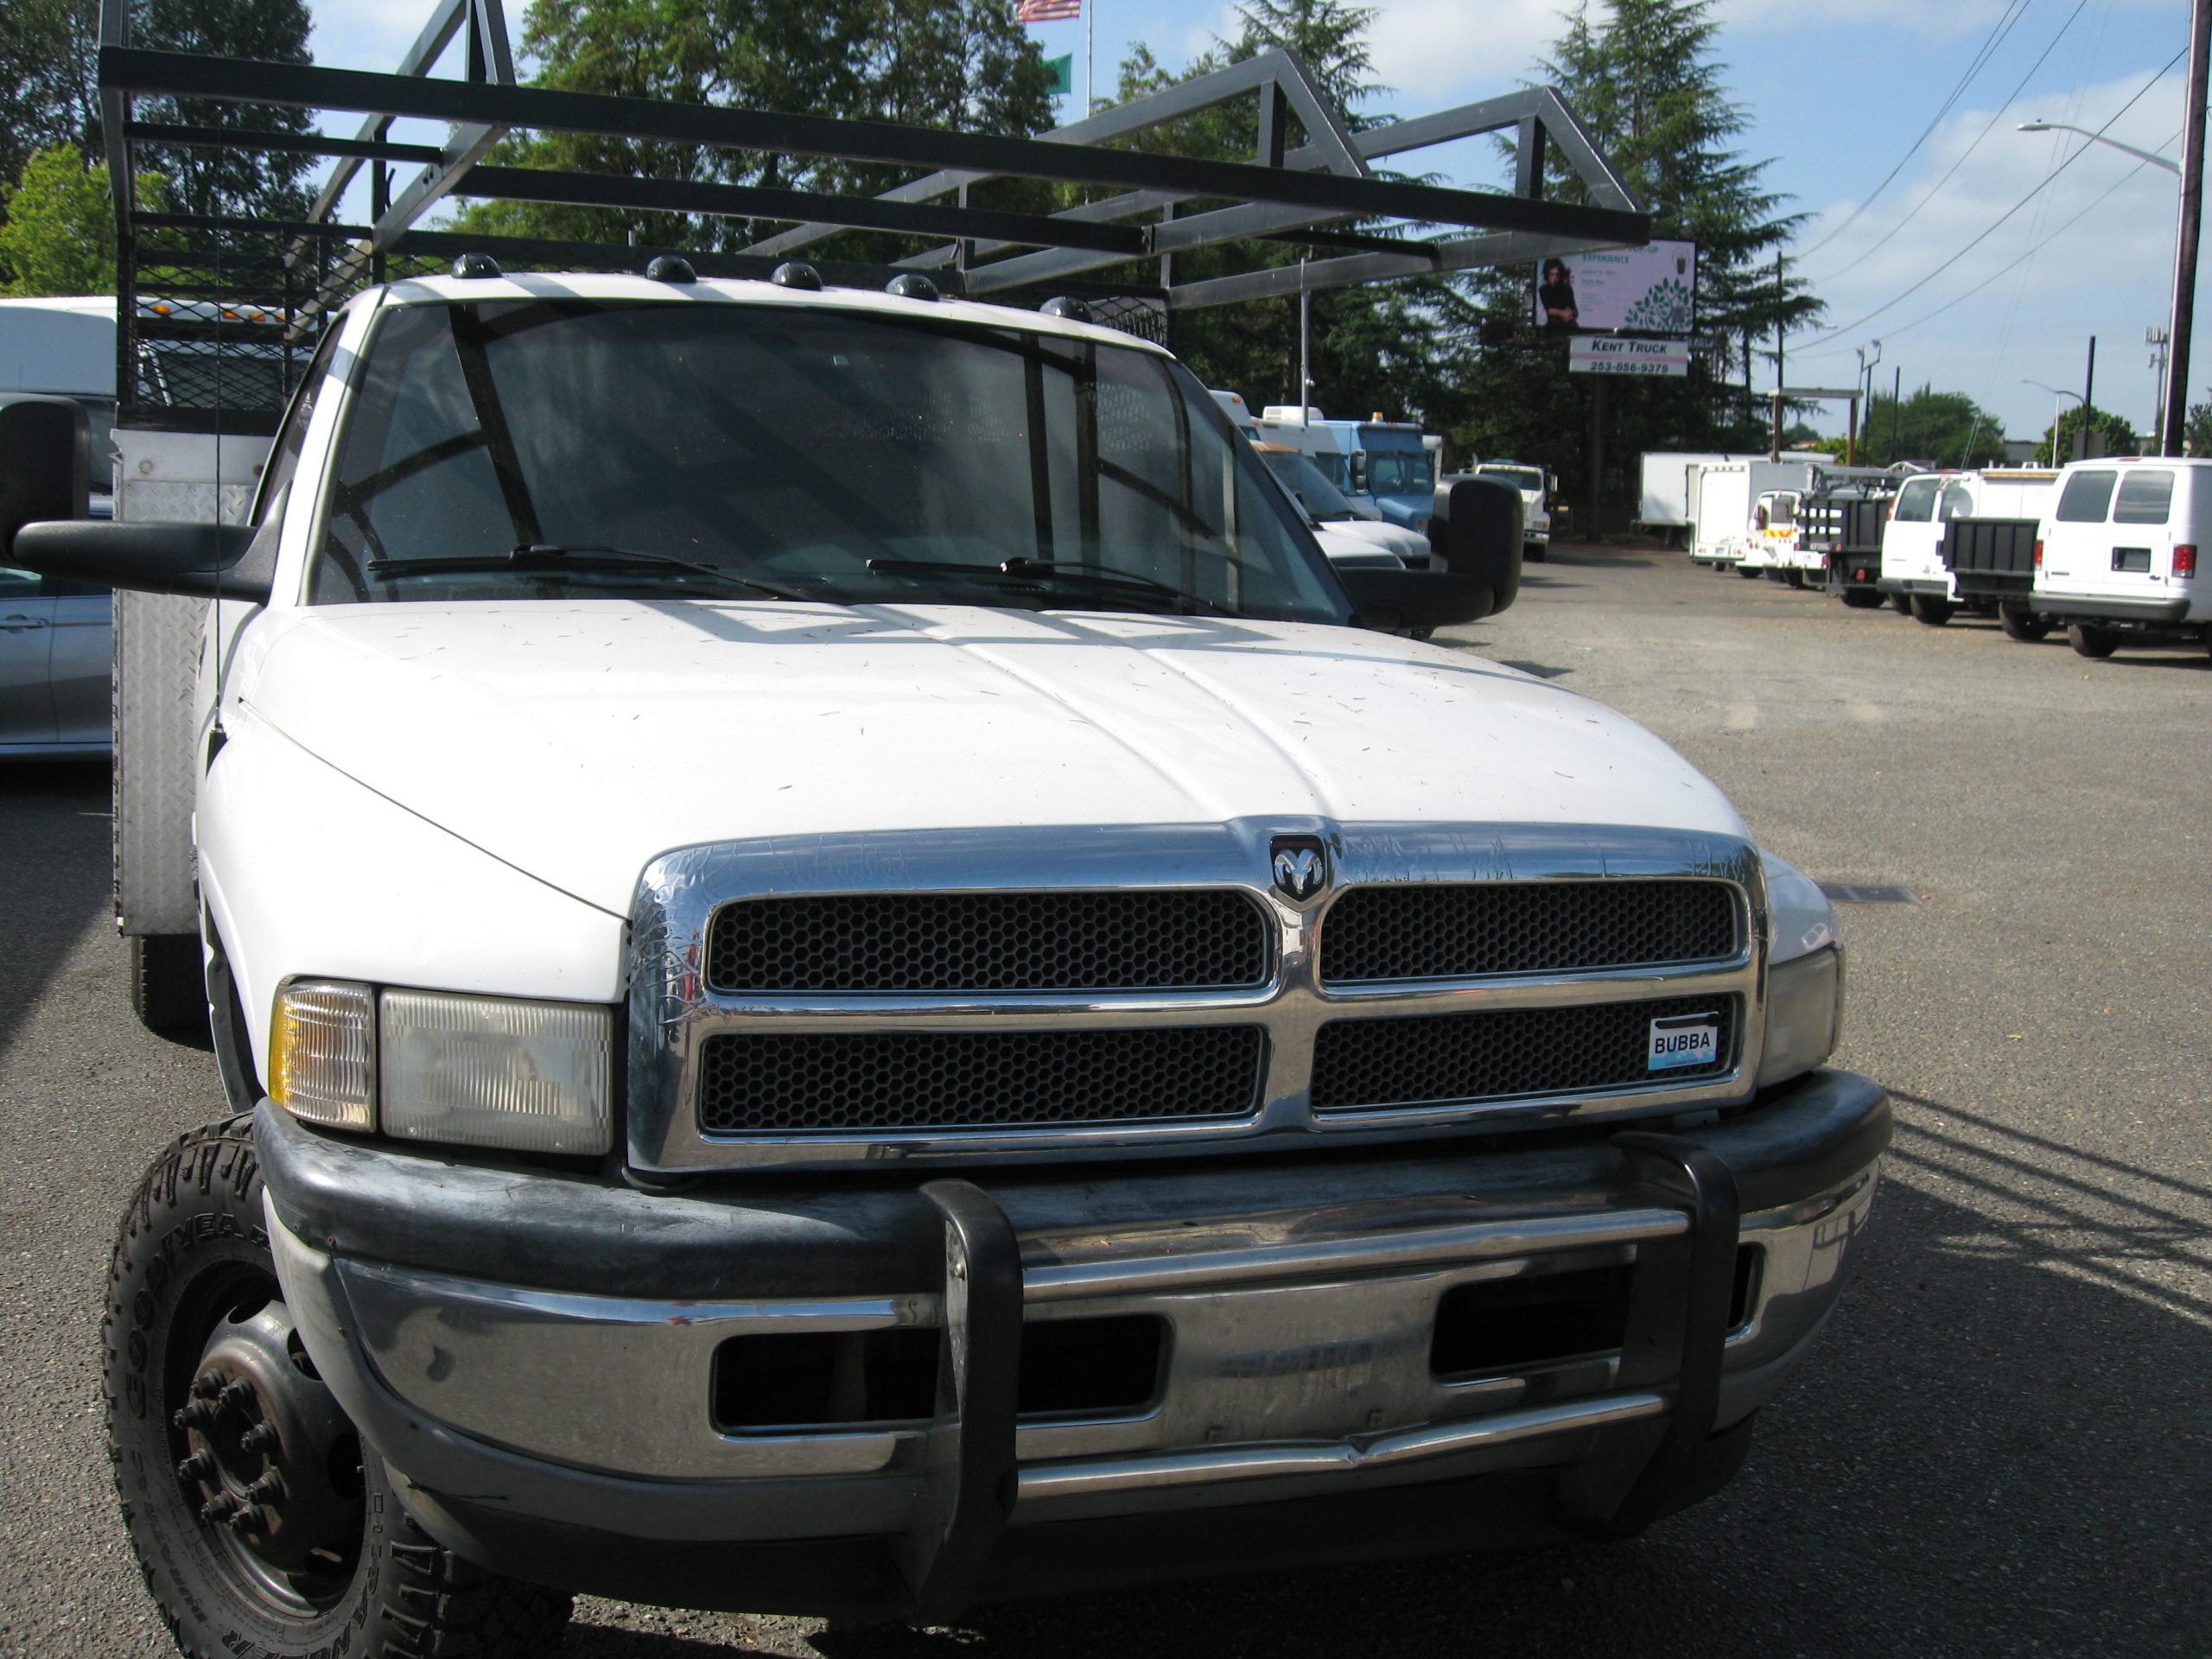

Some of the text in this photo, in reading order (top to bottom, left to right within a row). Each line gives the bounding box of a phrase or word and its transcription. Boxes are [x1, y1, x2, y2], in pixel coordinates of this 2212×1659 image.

[1583, 255, 1629, 264] EXPERIENCE
[1592, 362, 1669, 373] 253-856-9379
[1655, 1032, 1710, 1054] BUBBA
